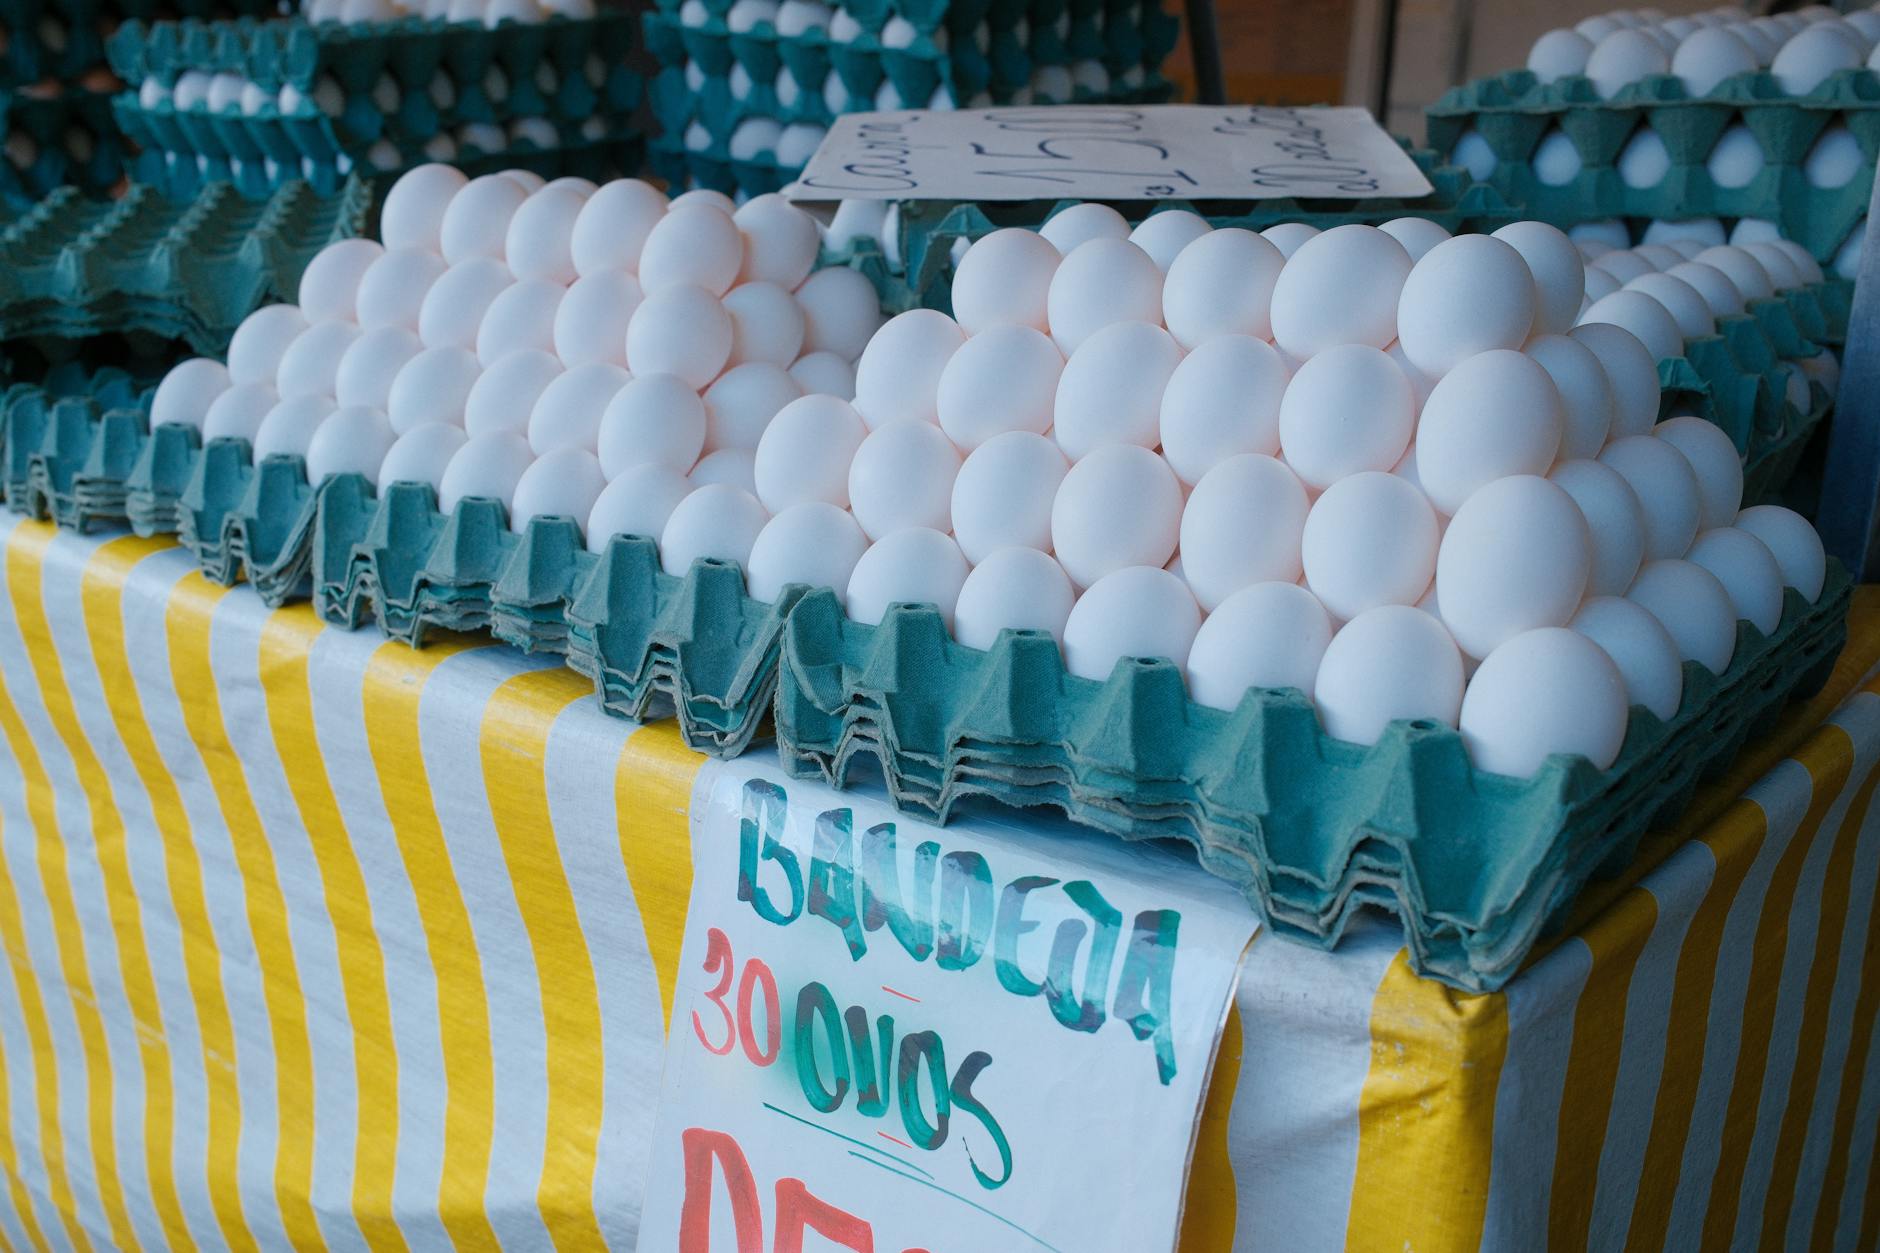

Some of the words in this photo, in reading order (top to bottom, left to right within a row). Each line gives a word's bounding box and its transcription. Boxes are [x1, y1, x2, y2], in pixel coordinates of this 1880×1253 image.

[691, 927, 782, 1068] 30
[796, 981, 1014, 1191] OVOS
[737, 778, 1182, 1086] BANDEJA
